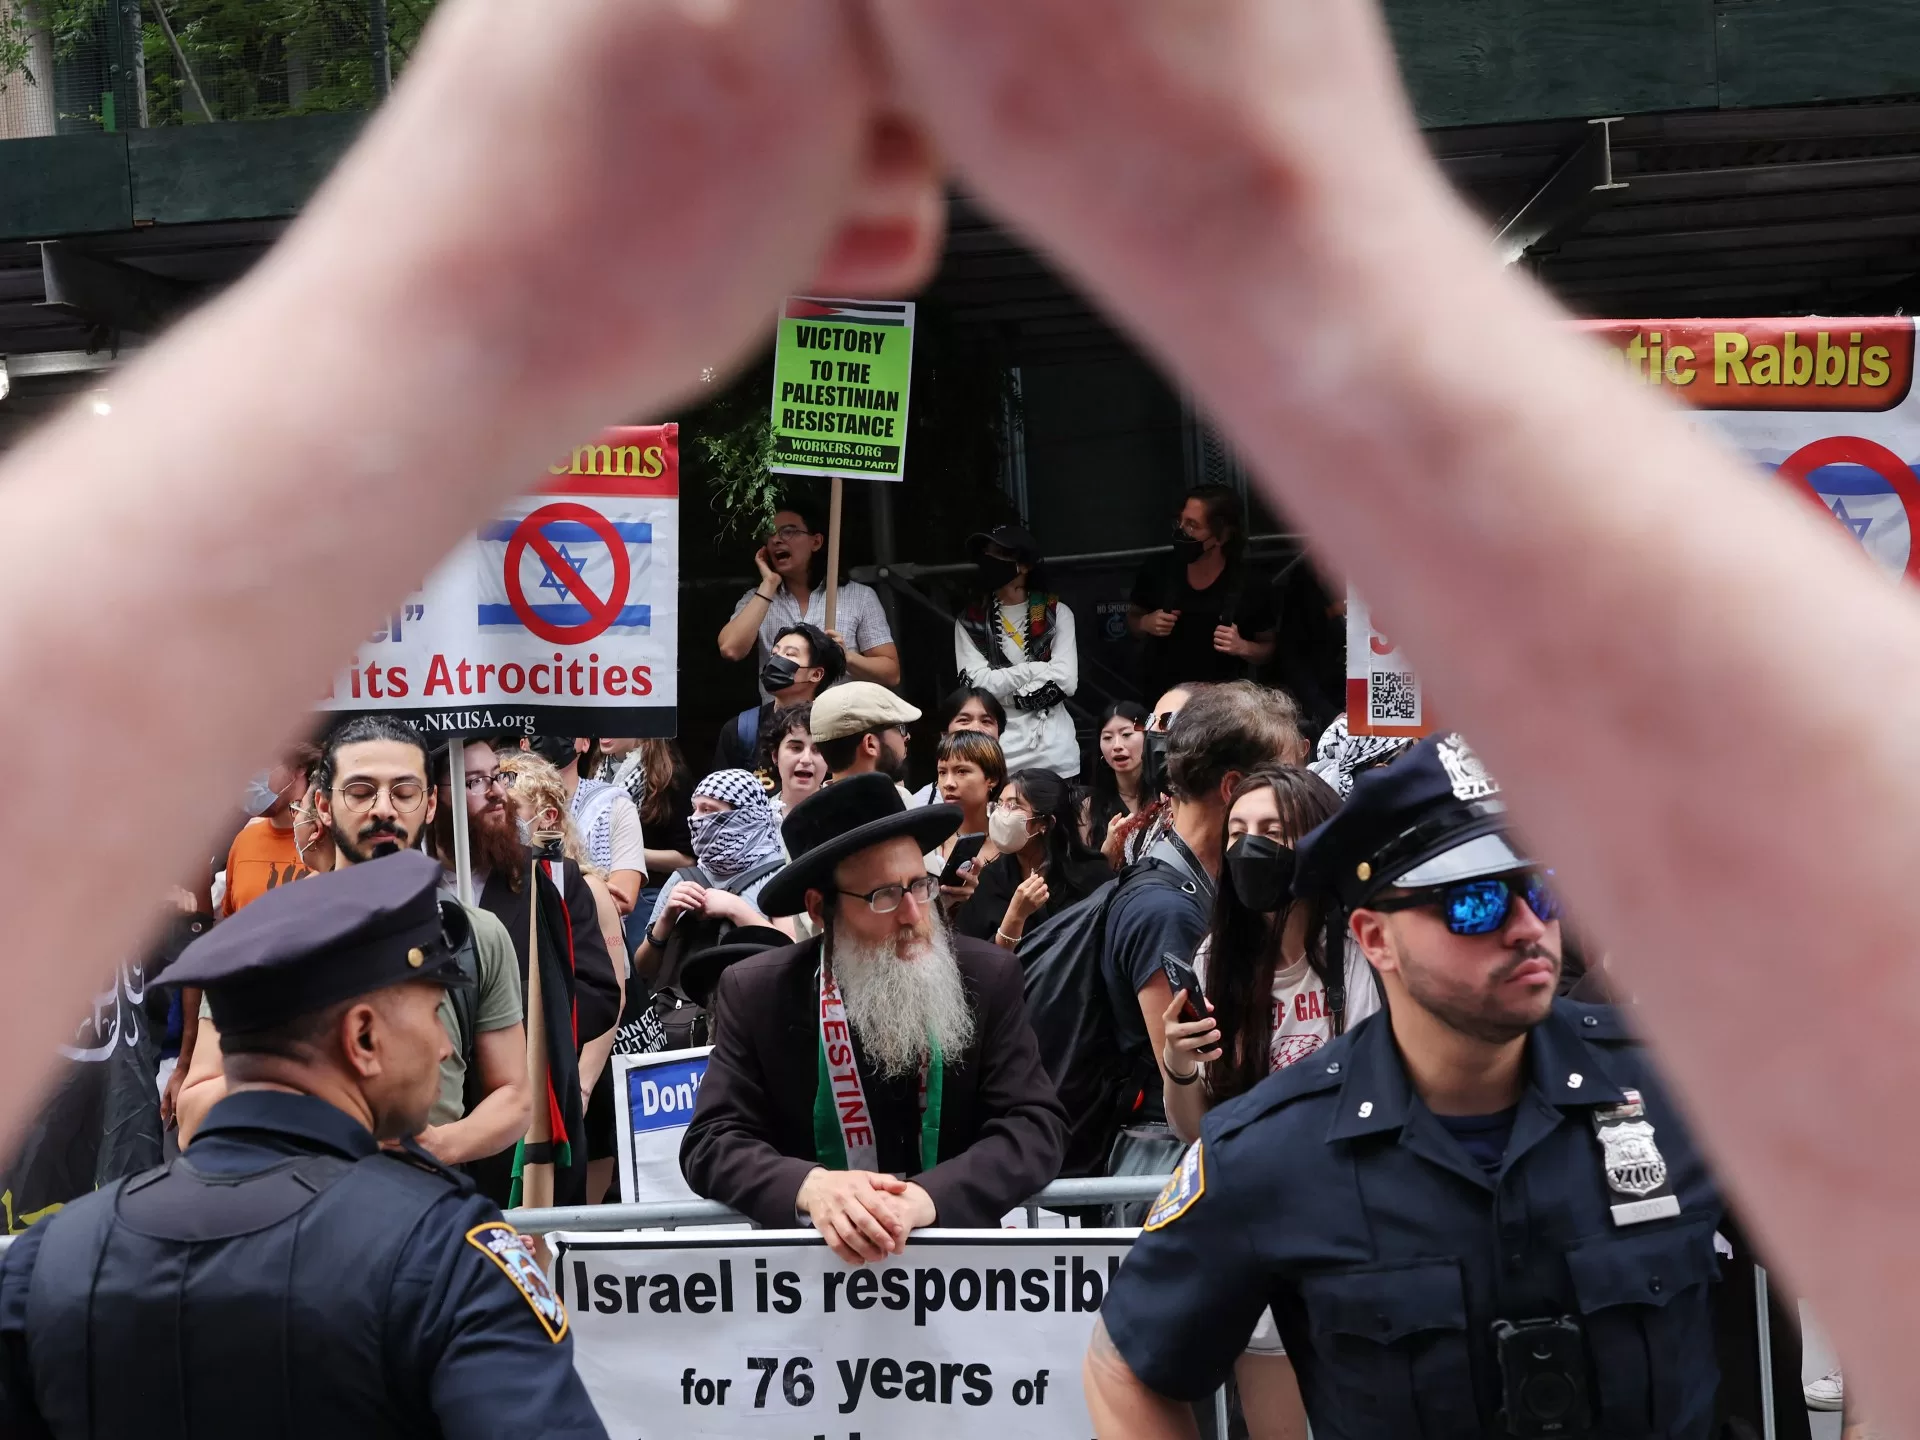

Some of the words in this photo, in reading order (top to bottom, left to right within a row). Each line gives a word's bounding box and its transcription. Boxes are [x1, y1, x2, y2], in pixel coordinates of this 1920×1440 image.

[796, 325, 886, 355] VICTORY
[810, 359, 833, 382] TO
[836, 361, 871, 384] THE
[1614, 331, 1697, 387] tic
[1713, 331, 1891, 387] Rabbis
[781, 381, 899, 412] PALESTINIAN
[782, 408, 895, 438] RESISTANCE
[775, 452, 824, 465] WORKERS
[826, 456, 862, 468] WORLD
[864, 460, 897, 470] PARTY
[791, 438, 882, 458] WORKERS.ORG
[350, 655, 409, 699] its
[423, 652, 654, 697] Atrocities
[402, 710, 536, 735] w.NKUSA.org
[1294, 990, 1333, 1022] GAZ
[615, 1005, 659, 1041] ONNECT.
[641, 1072, 706, 1117] Don'
[1566, 1073, 1584, 1089] 9
[1357, 1101, 1374, 1118] 9
[573, 1258, 734, 1314] Israel
[755, 1258, 802, 1314] is
[823, 1255, 1120, 1326] responsibl
[681, 1367, 732, 1406] for
[747, 1356, 815, 1409] 76
[836, 1357, 993, 1414] years
[1012, 1369, 1050, 1406] of
